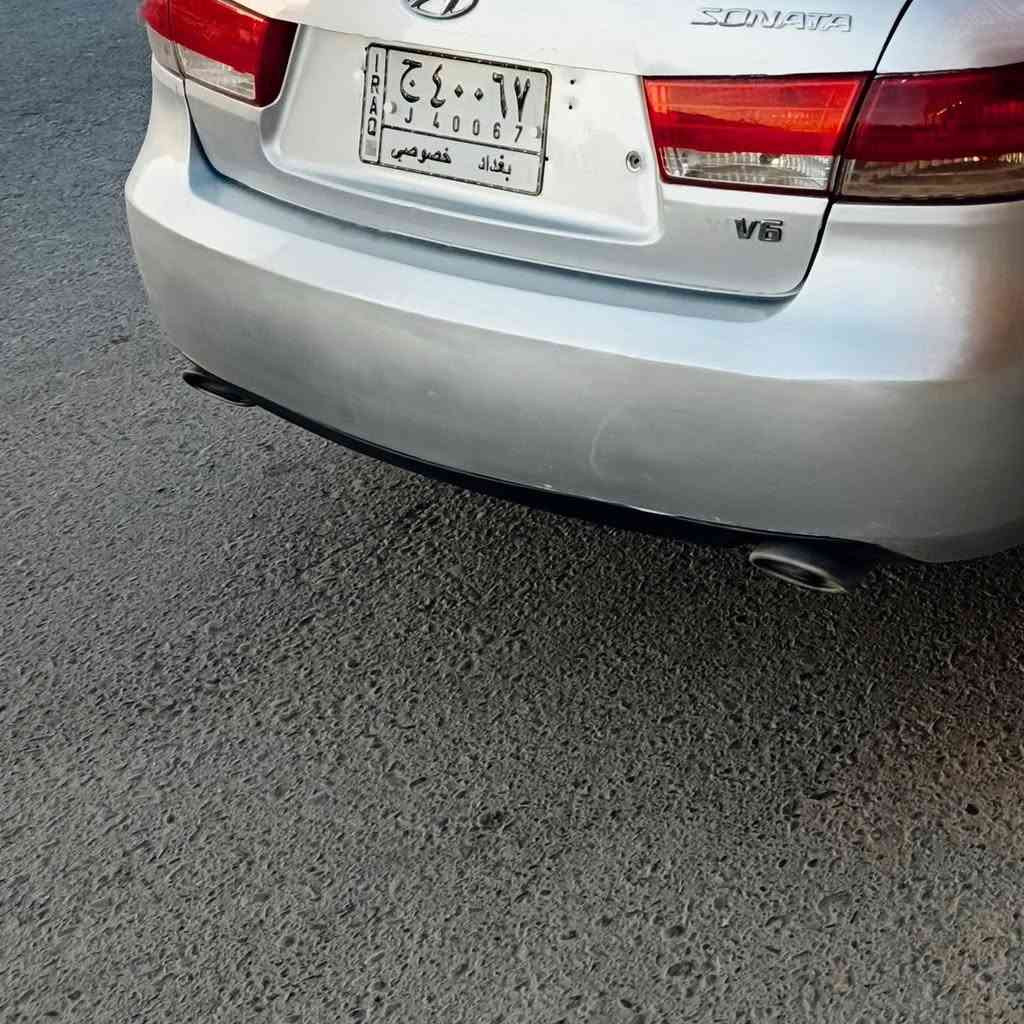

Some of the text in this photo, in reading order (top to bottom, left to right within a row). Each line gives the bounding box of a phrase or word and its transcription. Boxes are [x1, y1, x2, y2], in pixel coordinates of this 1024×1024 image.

[690, 7, 853, 32] SONATA
[367, 53, 381, 136] IRAQ
[390, 145, 512, 182] بغداد خصوصي
[734, 217, 784, 243] V6
